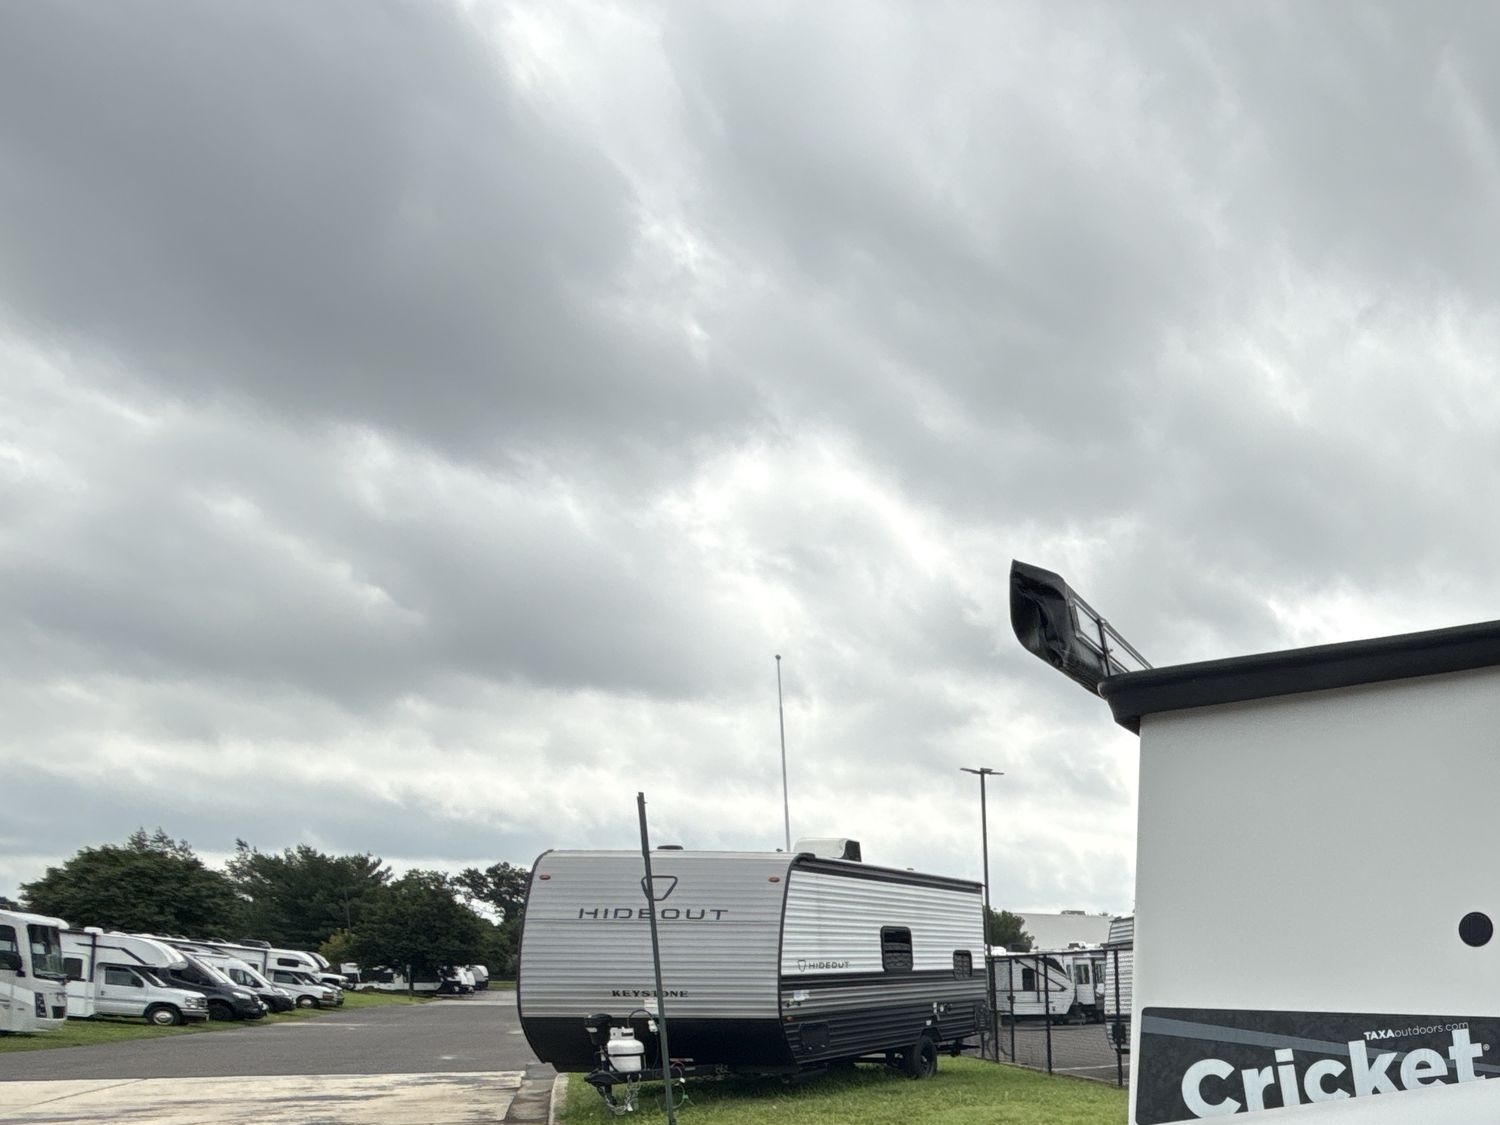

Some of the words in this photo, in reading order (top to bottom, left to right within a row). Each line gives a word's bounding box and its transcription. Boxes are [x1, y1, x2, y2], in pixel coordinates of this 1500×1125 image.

[578, 908, 729, 920] HIDEOUT
[808, 961, 849, 969] HIDEOUT
[1363, 1022, 1469, 1040] TAXAoutdoors.com
[1181, 1029, 1486, 1118] Cricket
